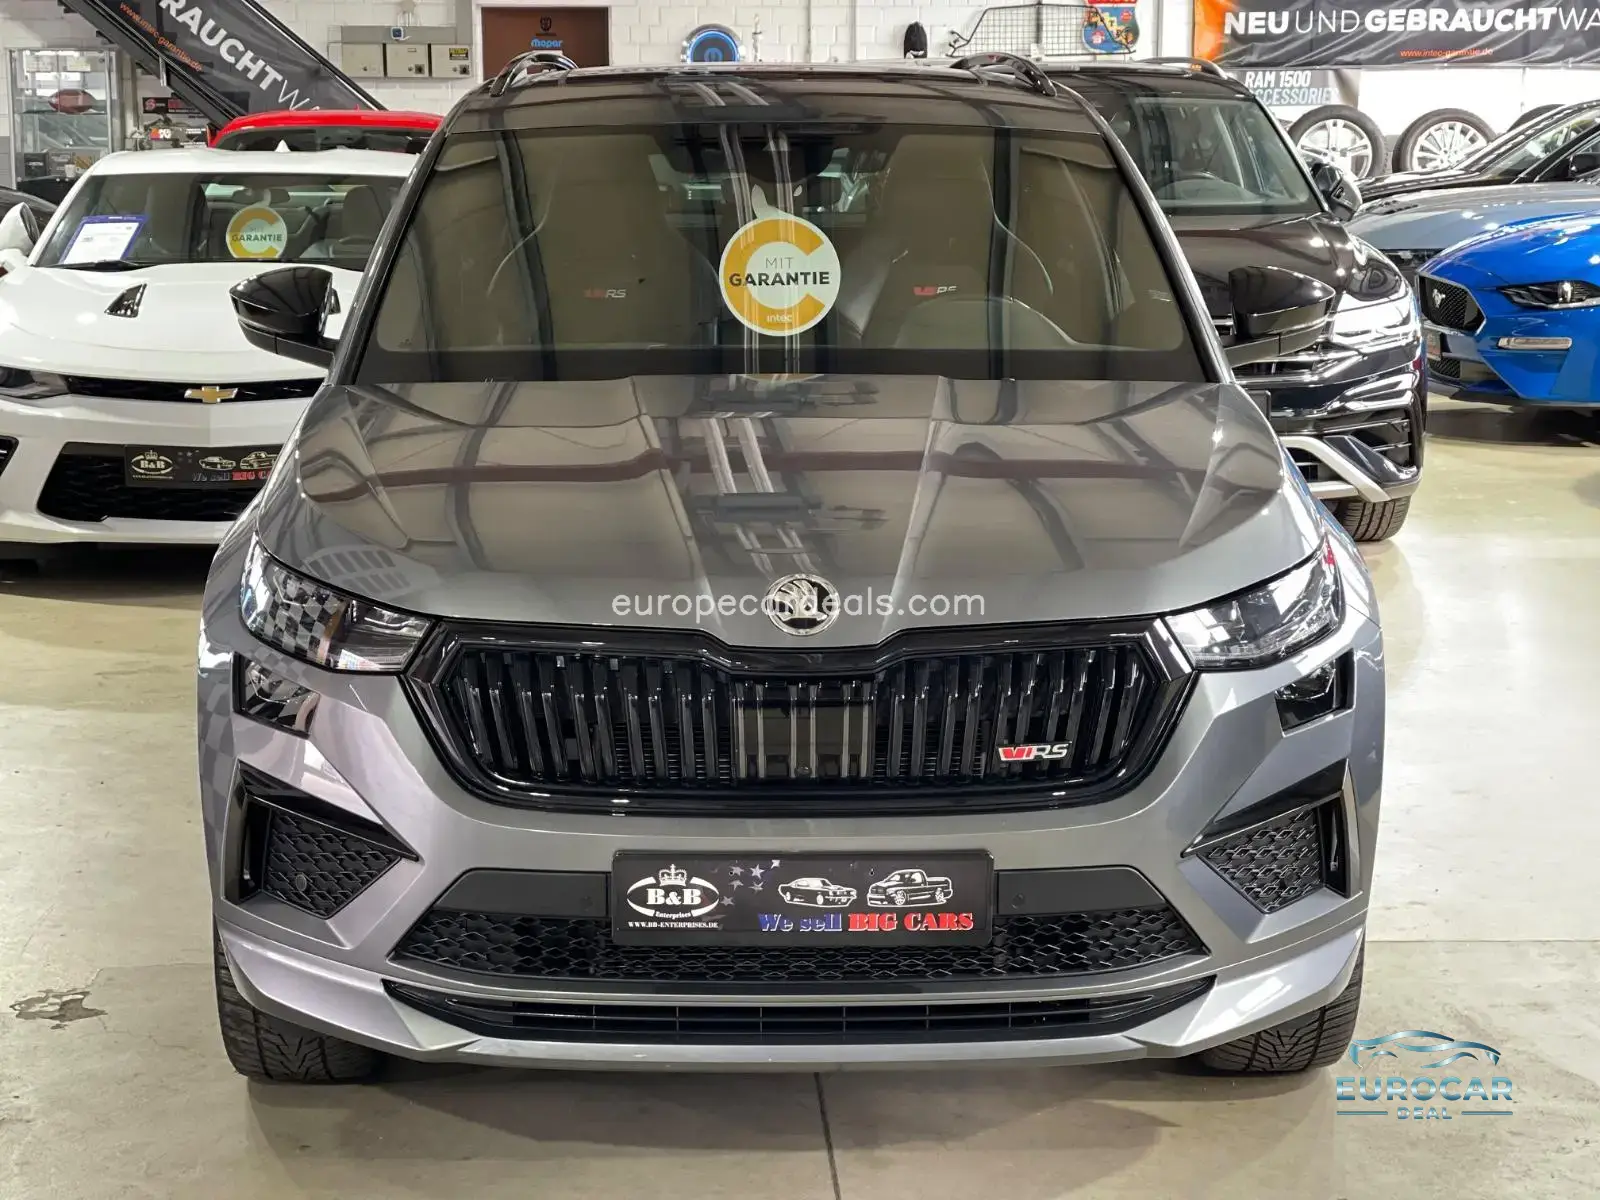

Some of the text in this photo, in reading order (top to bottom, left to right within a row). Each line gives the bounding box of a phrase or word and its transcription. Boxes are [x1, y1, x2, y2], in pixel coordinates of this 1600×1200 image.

[1224, 11, 1289, 34] NEU
[1295, 10, 1360, 33] UND
[159, 0, 320, 111] RAUCHTW
[1245, 70, 1312, 88] RAM 1500
[231, 233, 283, 241] GARANTIE
[765, 257, 793, 269] MIT
[729, 271, 830, 287] GARANTIE
[767, 314, 793, 323] intec
[140, 460, 165, 469] B&B
[646, 888, 702, 906] B&B
[655, 911, 692, 920] Enterprises
[758, 912, 974, 931] We sell BIG CARS
